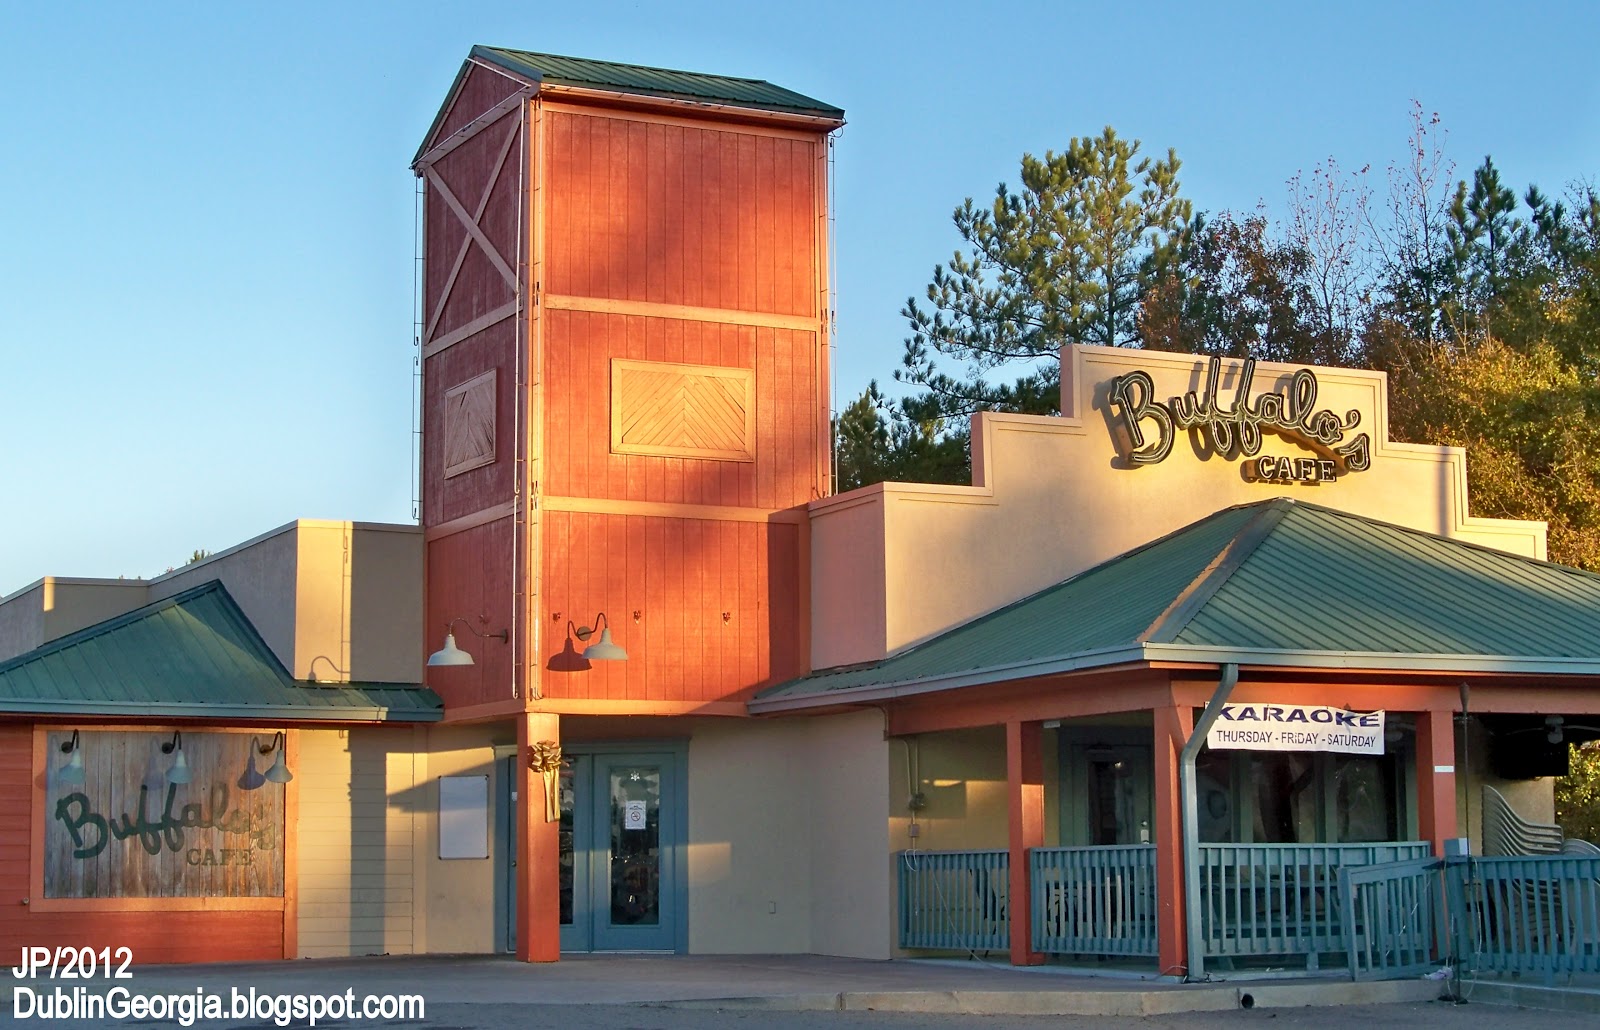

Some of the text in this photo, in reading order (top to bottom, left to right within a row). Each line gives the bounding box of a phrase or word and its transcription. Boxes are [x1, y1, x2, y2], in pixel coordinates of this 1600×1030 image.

[1255, 456, 1337, 482] CAFE
[1218, 706, 1380, 727] KARAOKE
[1216, 730, 1273, 743] THURSDAY
[1327, 733, 1376, 748] SATURDAY
[186, 848, 253, 866] CAFE
